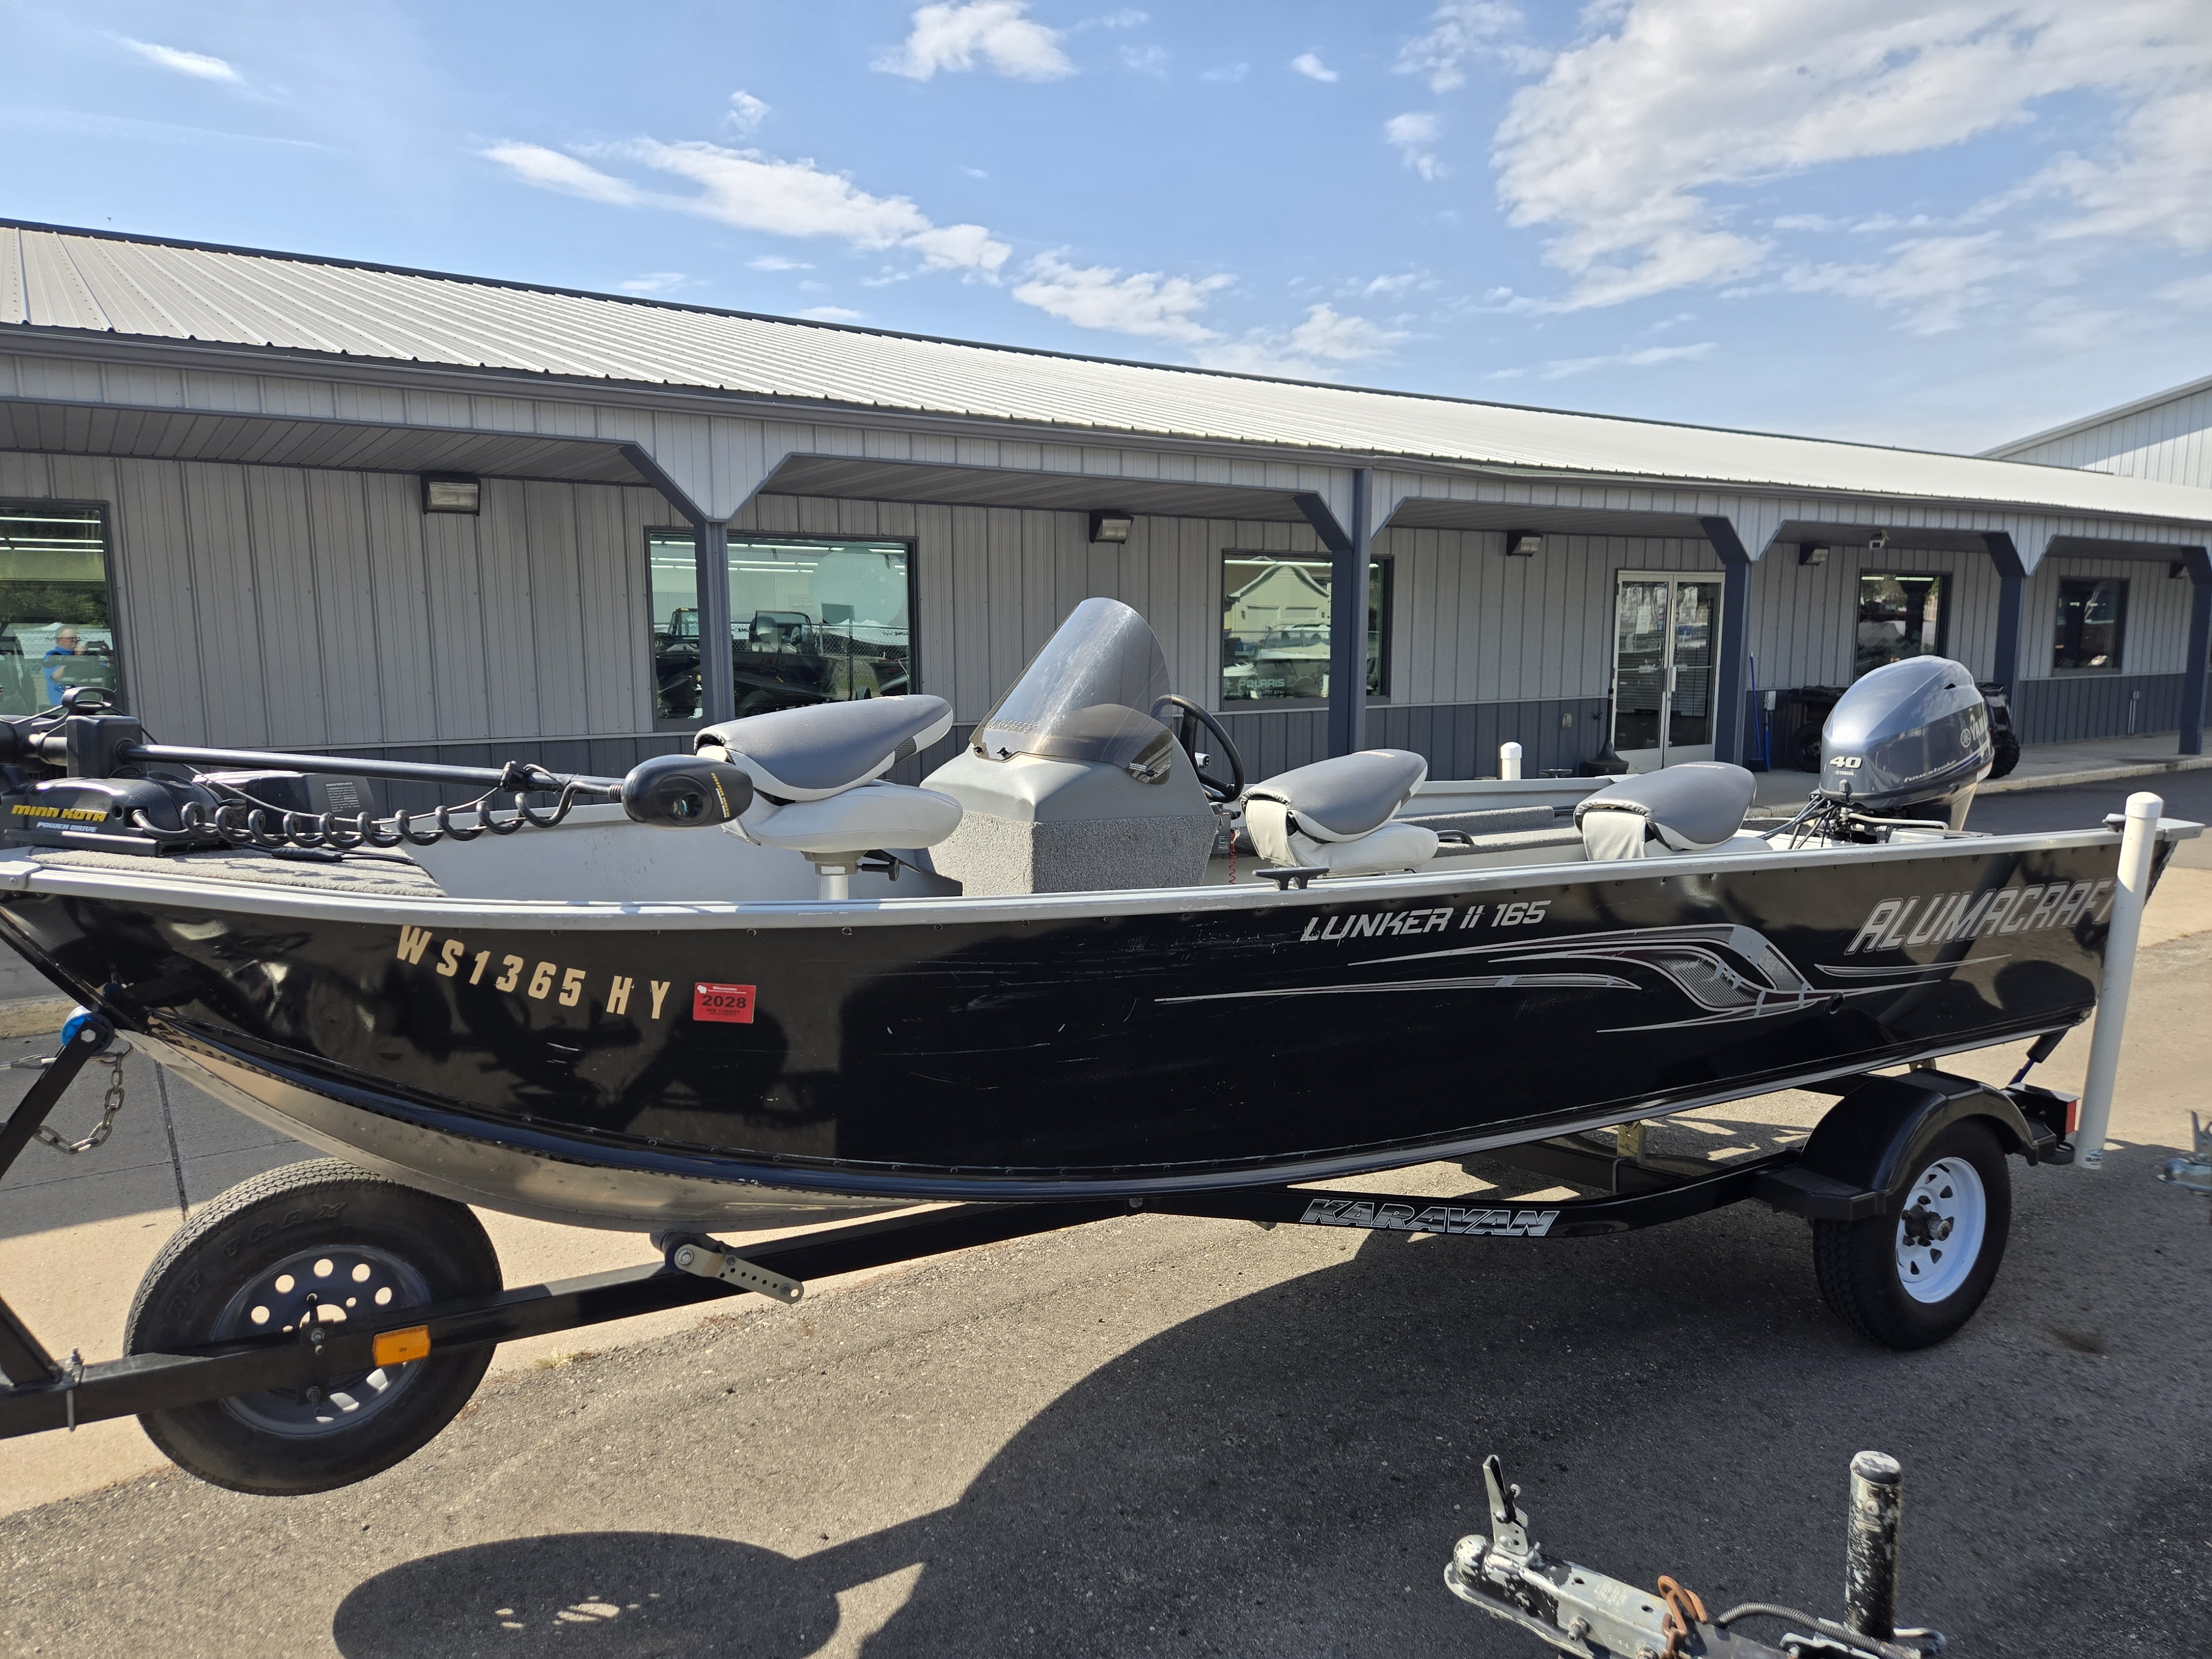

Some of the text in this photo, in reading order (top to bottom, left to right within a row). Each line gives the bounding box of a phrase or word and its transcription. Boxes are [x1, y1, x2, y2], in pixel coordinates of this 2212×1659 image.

[1239, 678, 1285, 687] POLARIS
[1830, 756, 1862, 769] 40
[1903, 759, 1957, 783] fourstroke
[711, 773, 724, 796] MINN
[11, 805, 108, 822] MINN KOTA
[70, 824, 97, 832] DRIVE
[1300, 900, 1552, 942] LUNKER II 165
[702, 995, 747, 1008] 2028
[1300, 1199, 1560, 1236] KARAVAN
[223, 1202, 347, 1256] TRAX
